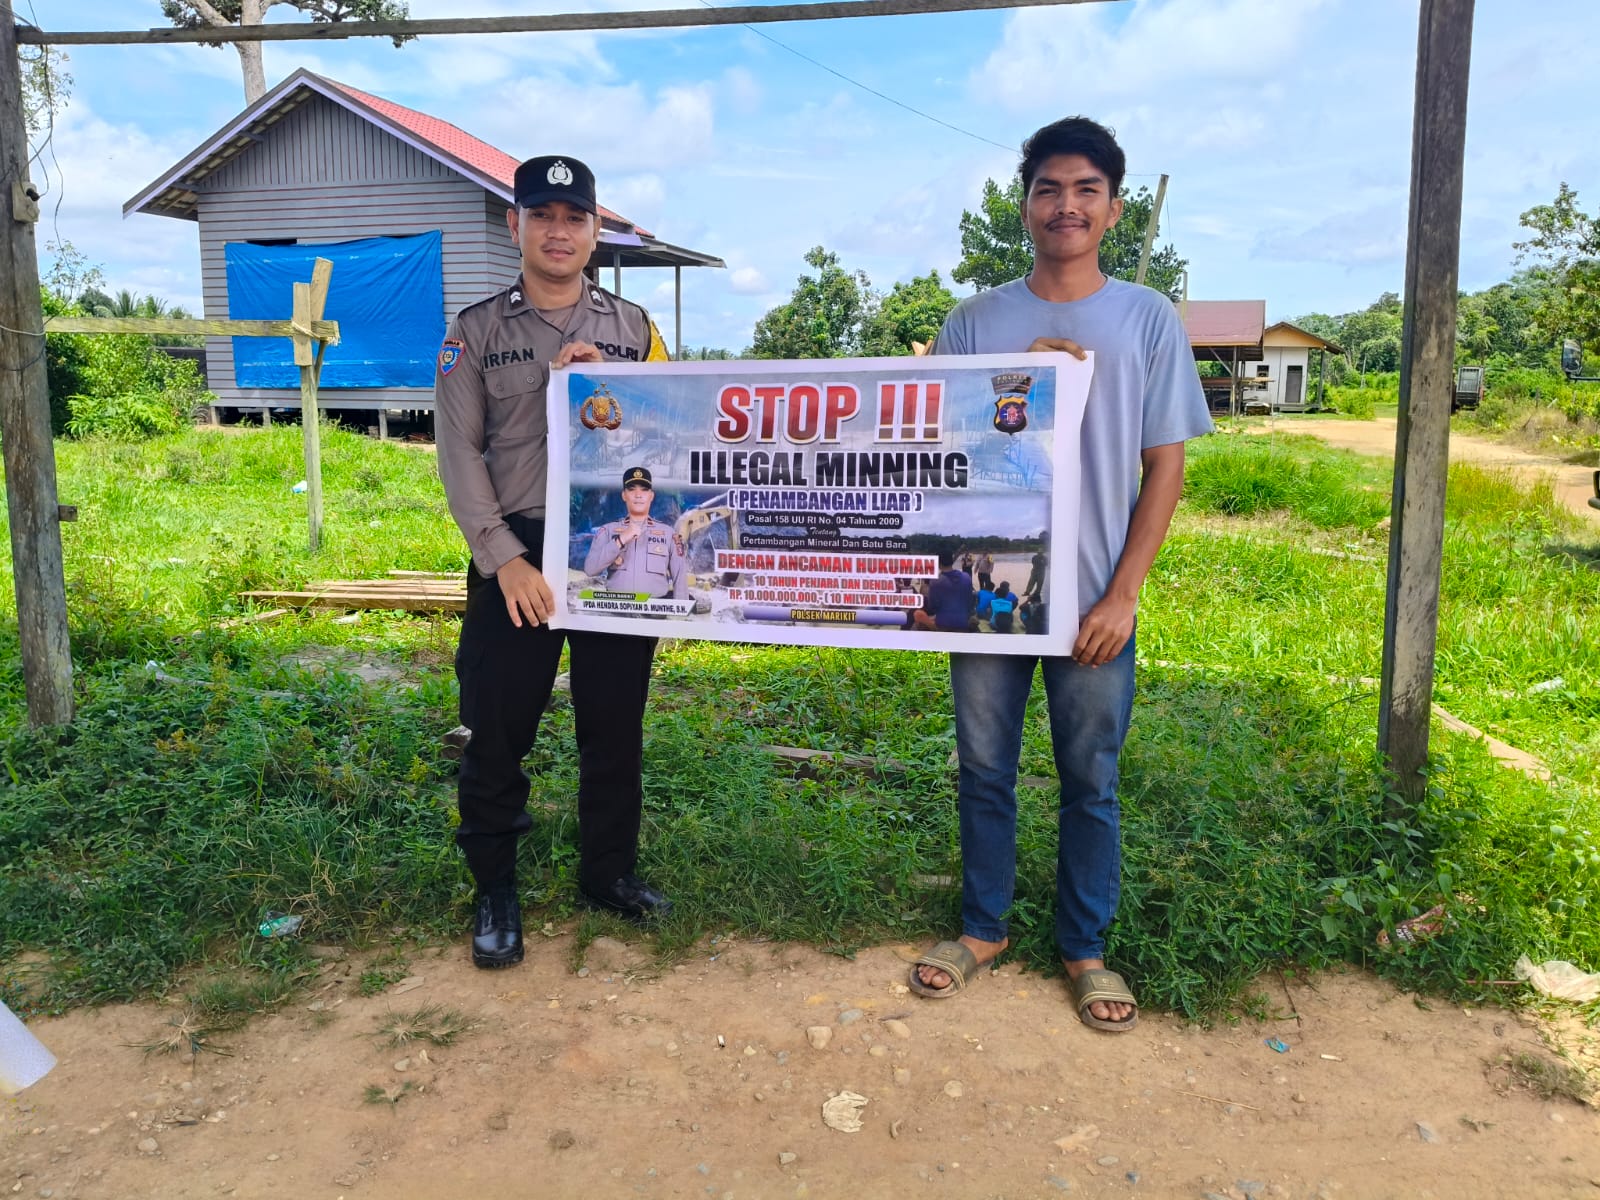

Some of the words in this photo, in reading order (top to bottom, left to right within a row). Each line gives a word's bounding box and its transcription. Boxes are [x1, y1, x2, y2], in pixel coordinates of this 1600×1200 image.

[484, 348, 534, 369] IRFAN
[715, 383, 859, 443] STOP
[877, 382, 943, 442] !!!
[690, 451, 806, 485] ILLEGAL
[815, 452, 968, 487] MINNING
[740, 491, 867, 511] PENAMBANGAN
[872, 492, 911, 511] LIAR
[748, 514, 772, 523] Pasal
[775, 515, 790, 524] 158
[792, 515, 805, 524] UU
[808, 515, 817, 524] RI
[819, 516, 834, 525] No.
[836, 516, 847, 525] 04
[849, 516, 877, 525] Tahun
[879, 517, 900, 526] 2009
[810, 526, 838, 537] Tentang
[743, 536, 805, 548] Pertambangan
[808, 538, 840, 547] Mineral
[843, 539, 860, 548] Dan
[863, 540, 884, 549] Batu
[886, 540, 907, 549] Bara
[718, 553, 775, 571] DENGAN
[778, 555, 851, 573] ANCAMAN
[856, 557, 935, 576] HUKUMAN
[755, 575, 766, 587] 10
[768, 576, 798, 588] TAHUN
[800, 577, 840, 589] PENJARA
[841, 578, 860, 590] DAN
[862, 579, 894, 591] DENDA
[583, 600, 596, 609] IPDA
[596, 601, 619, 610] HENDRA
[619, 602, 643, 611] SOPIYAN
[729, 588, 743, 600] RP.
[831, 592, 841, 604] 10
[843, 593, 878, 605] MILYAR
[879, 594, 916, 606] RUPIAH
[791, 610, 822, 621] POLSEK
[823, 611, 857, 622] MARIKIT
